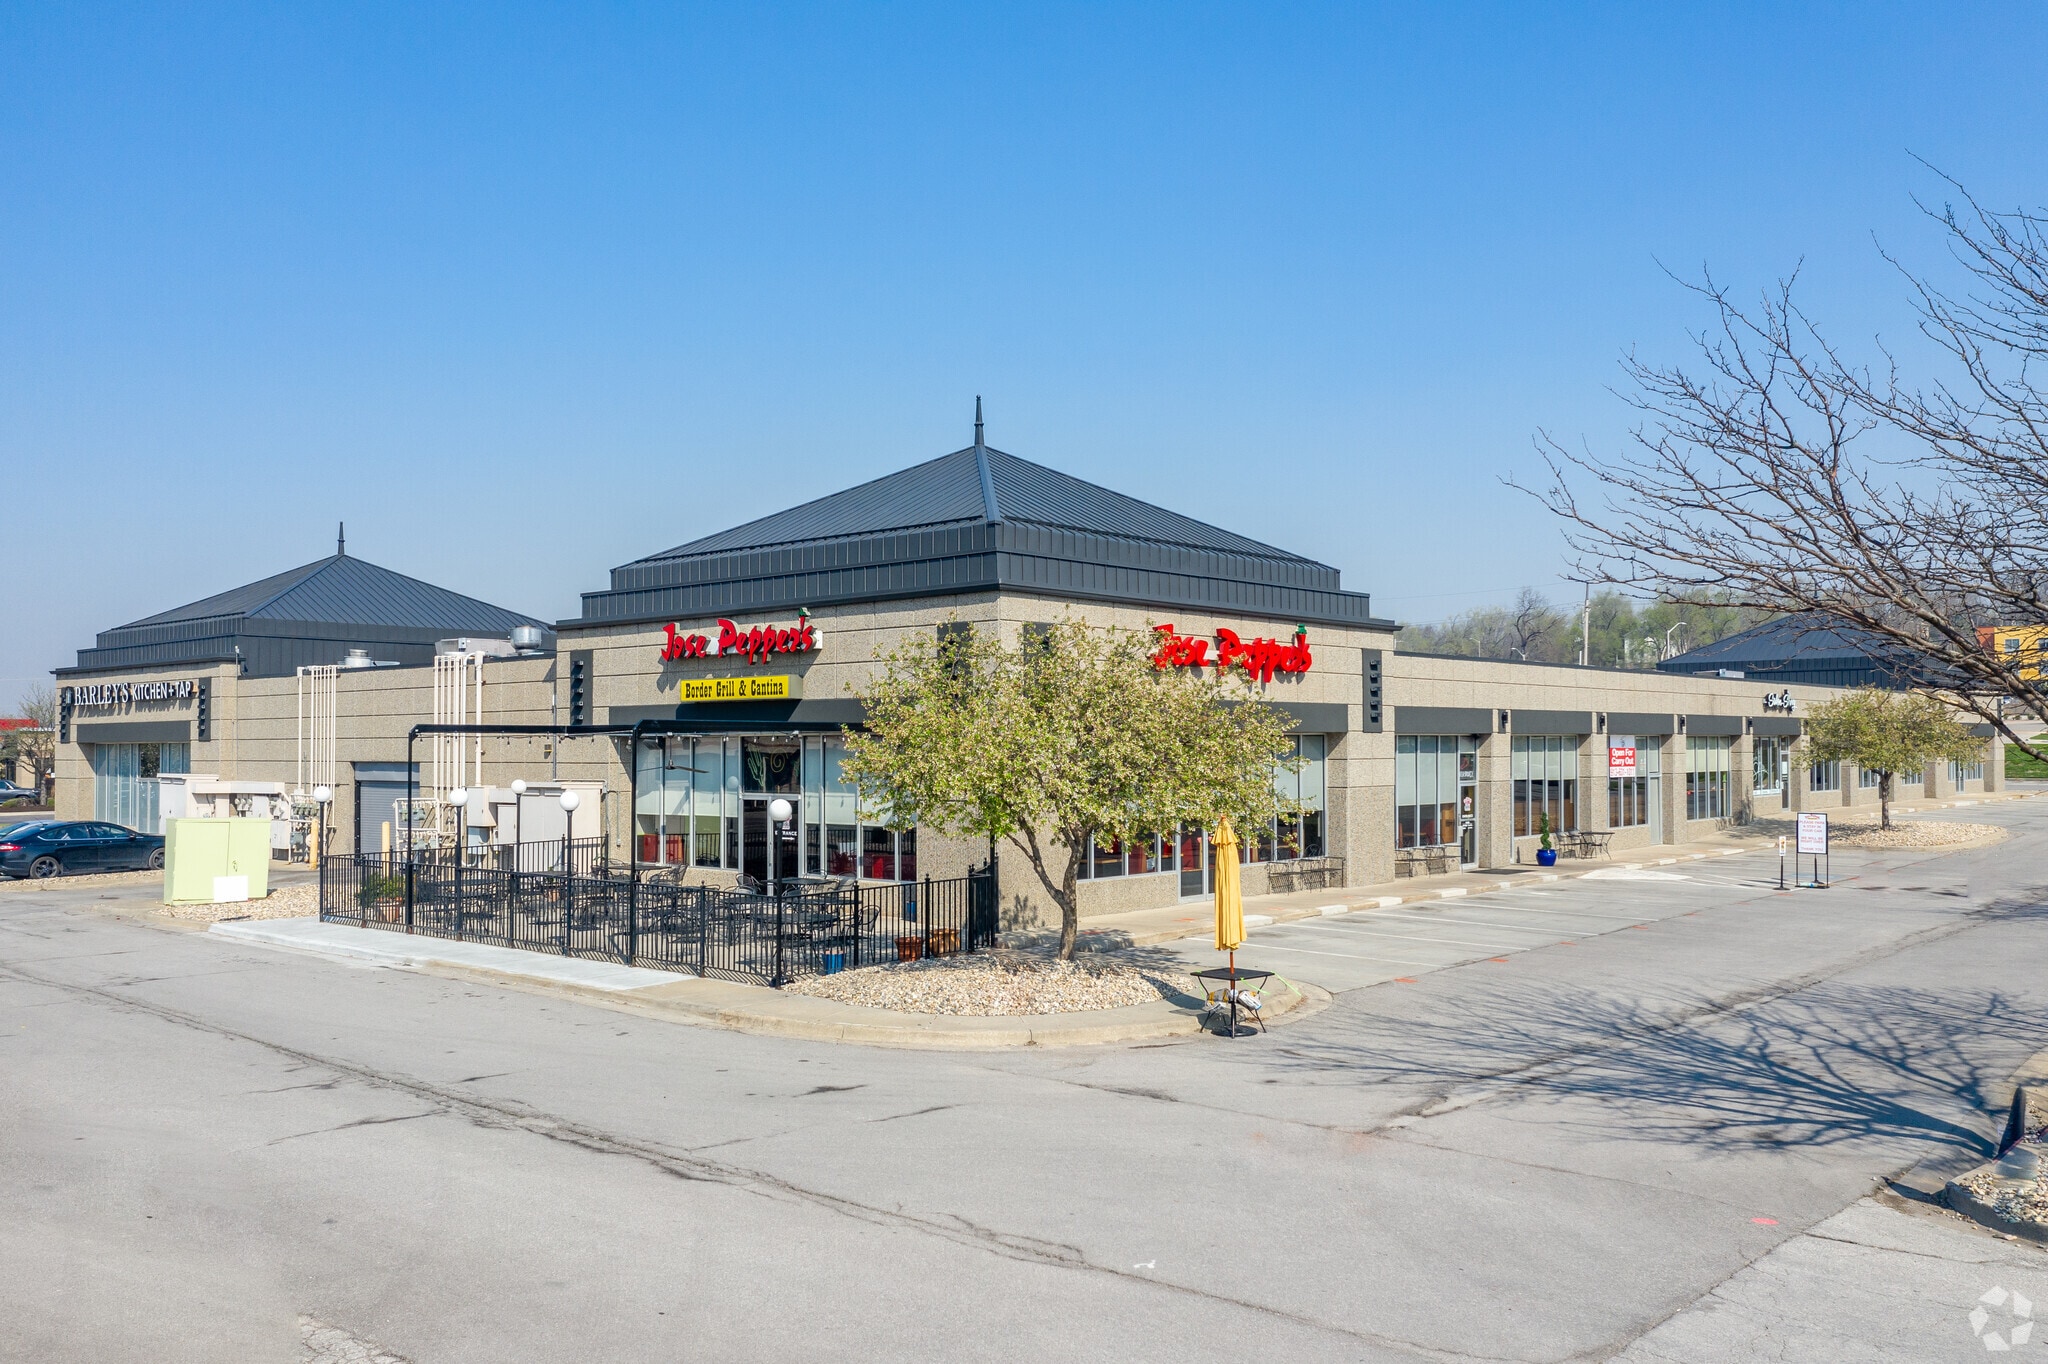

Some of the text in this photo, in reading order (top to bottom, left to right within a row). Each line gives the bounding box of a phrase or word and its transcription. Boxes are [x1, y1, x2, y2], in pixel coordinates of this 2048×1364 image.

[661, 610, 815, 665] Jose Pepper's
[74, 682, 129, 706] BARLEY'S
[685, 678, 783, 699] Border Grill & Cantina
[1611, 748, 1634, 758] Open For
[1611, 756, 1635, 766] Carry Out
